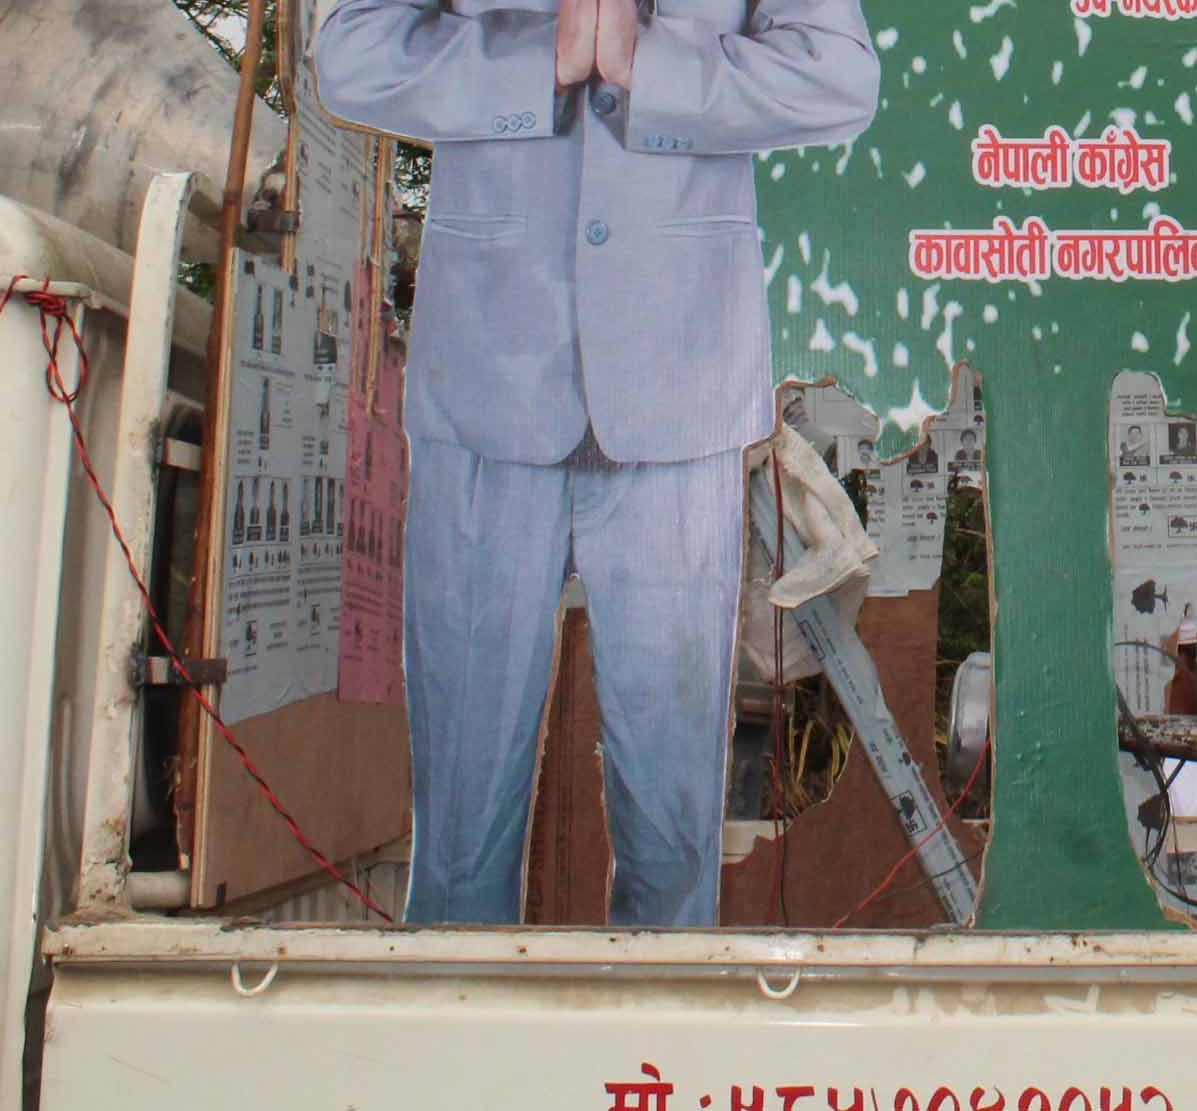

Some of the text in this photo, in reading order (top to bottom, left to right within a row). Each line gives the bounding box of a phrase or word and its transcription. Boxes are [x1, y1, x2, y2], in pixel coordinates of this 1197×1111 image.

[976, 128, 1168, 190] नेपाली काँग्रेस
[914, 219, 1048, 279] कावासोती
